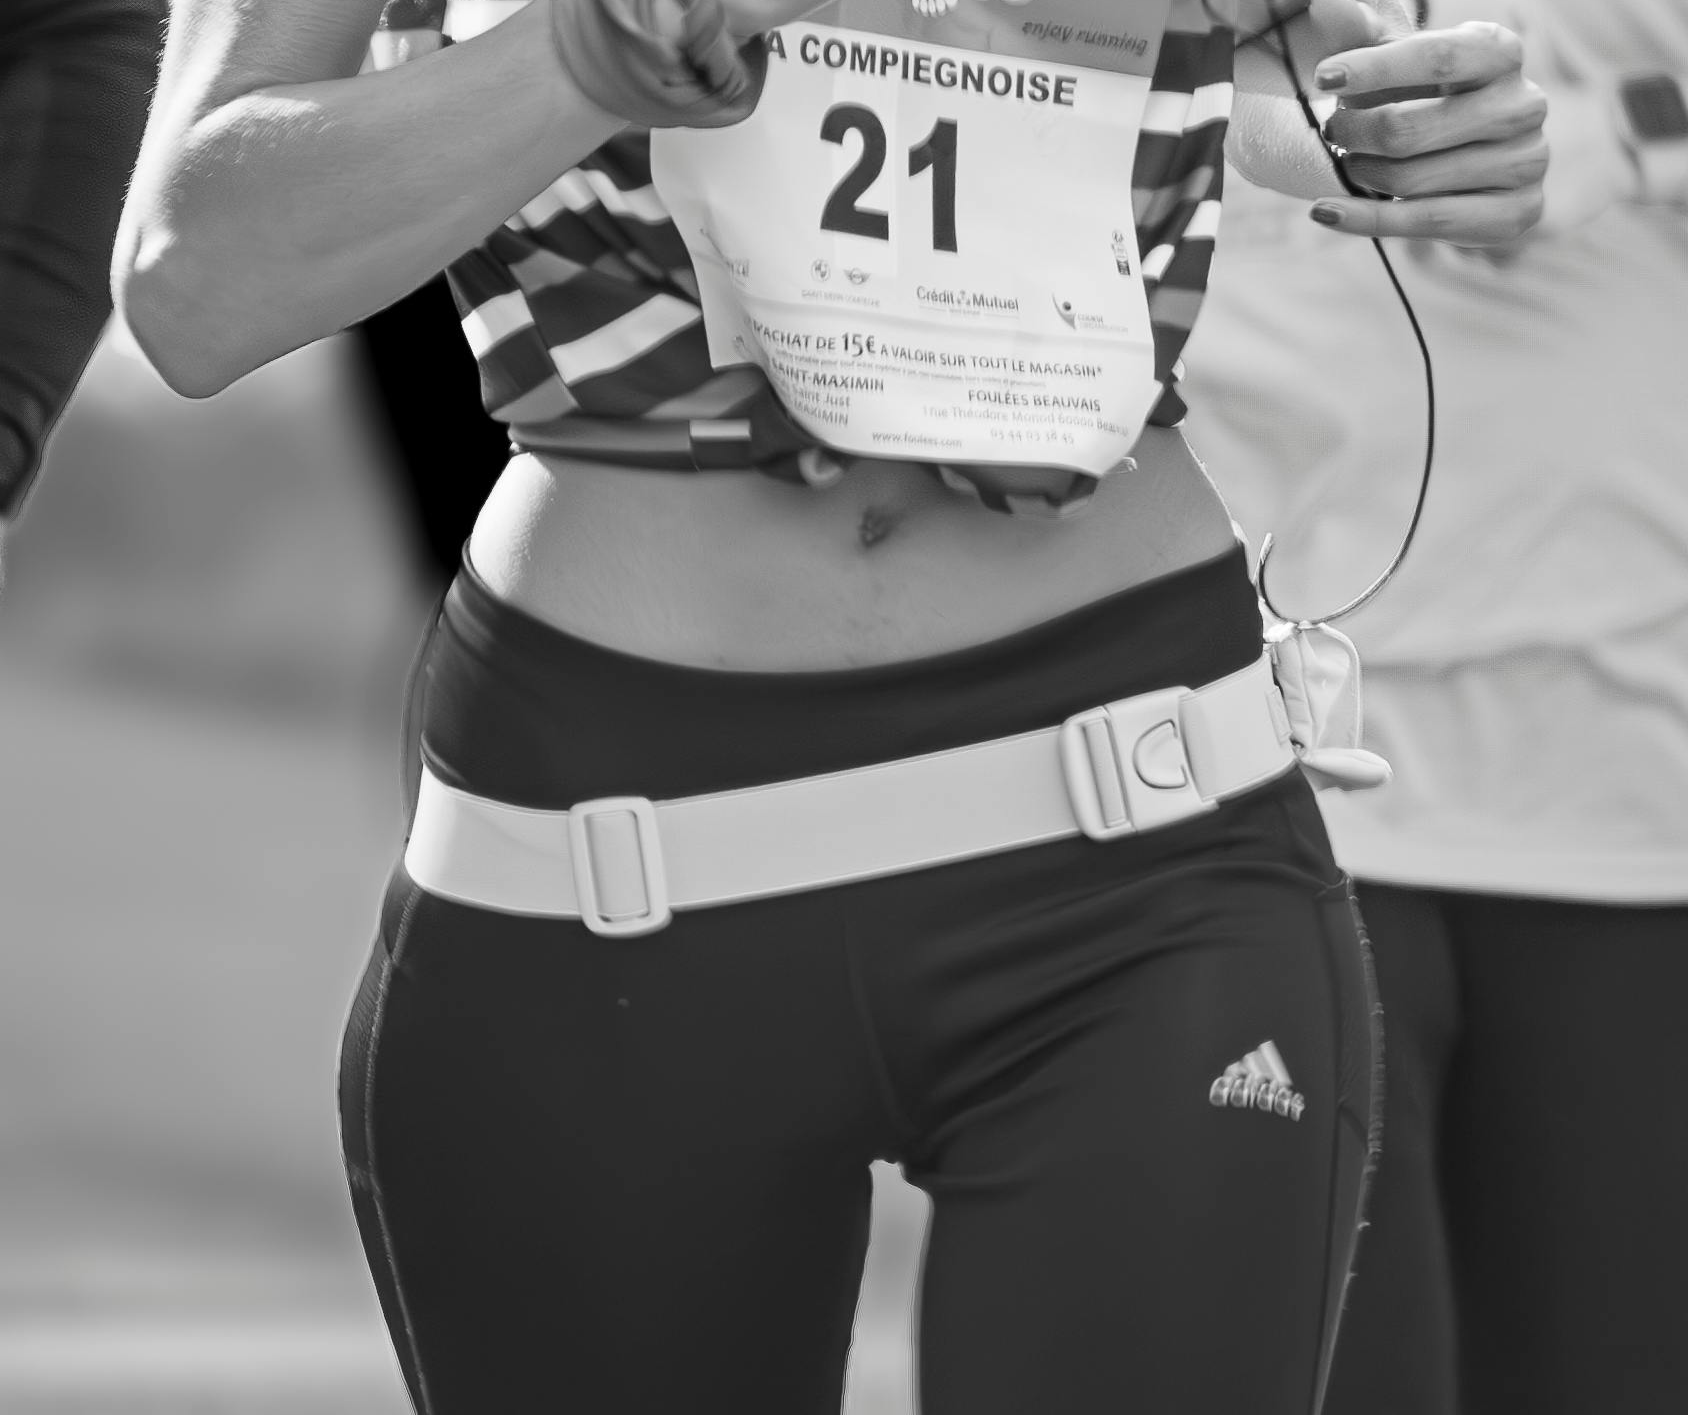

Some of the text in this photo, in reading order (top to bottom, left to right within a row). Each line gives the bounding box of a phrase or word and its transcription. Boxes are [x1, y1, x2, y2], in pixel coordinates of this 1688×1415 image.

[1021, 20, 1149, 57] enjoy running
[799, 33, 1078, 107] COMPIEGNOISE
[820, 101, 959, 254] 21
[916, 285, 955, 306] Crédit
[972, 292, 1019, 312] Mutuel
[816, 335, 836, 351] DE
[841, 332, 876, 357] 15€
[880, 344, 889, 356] A
[891, 345, 936, 365] VALOIR
[939, 352, 967, 368] SUR
[970, 355, 1009, 370] TOUT
[1011, 359, 1025, 373] LE
[968, 388, 1101, 413] FOULÉES BEAUVAIS
